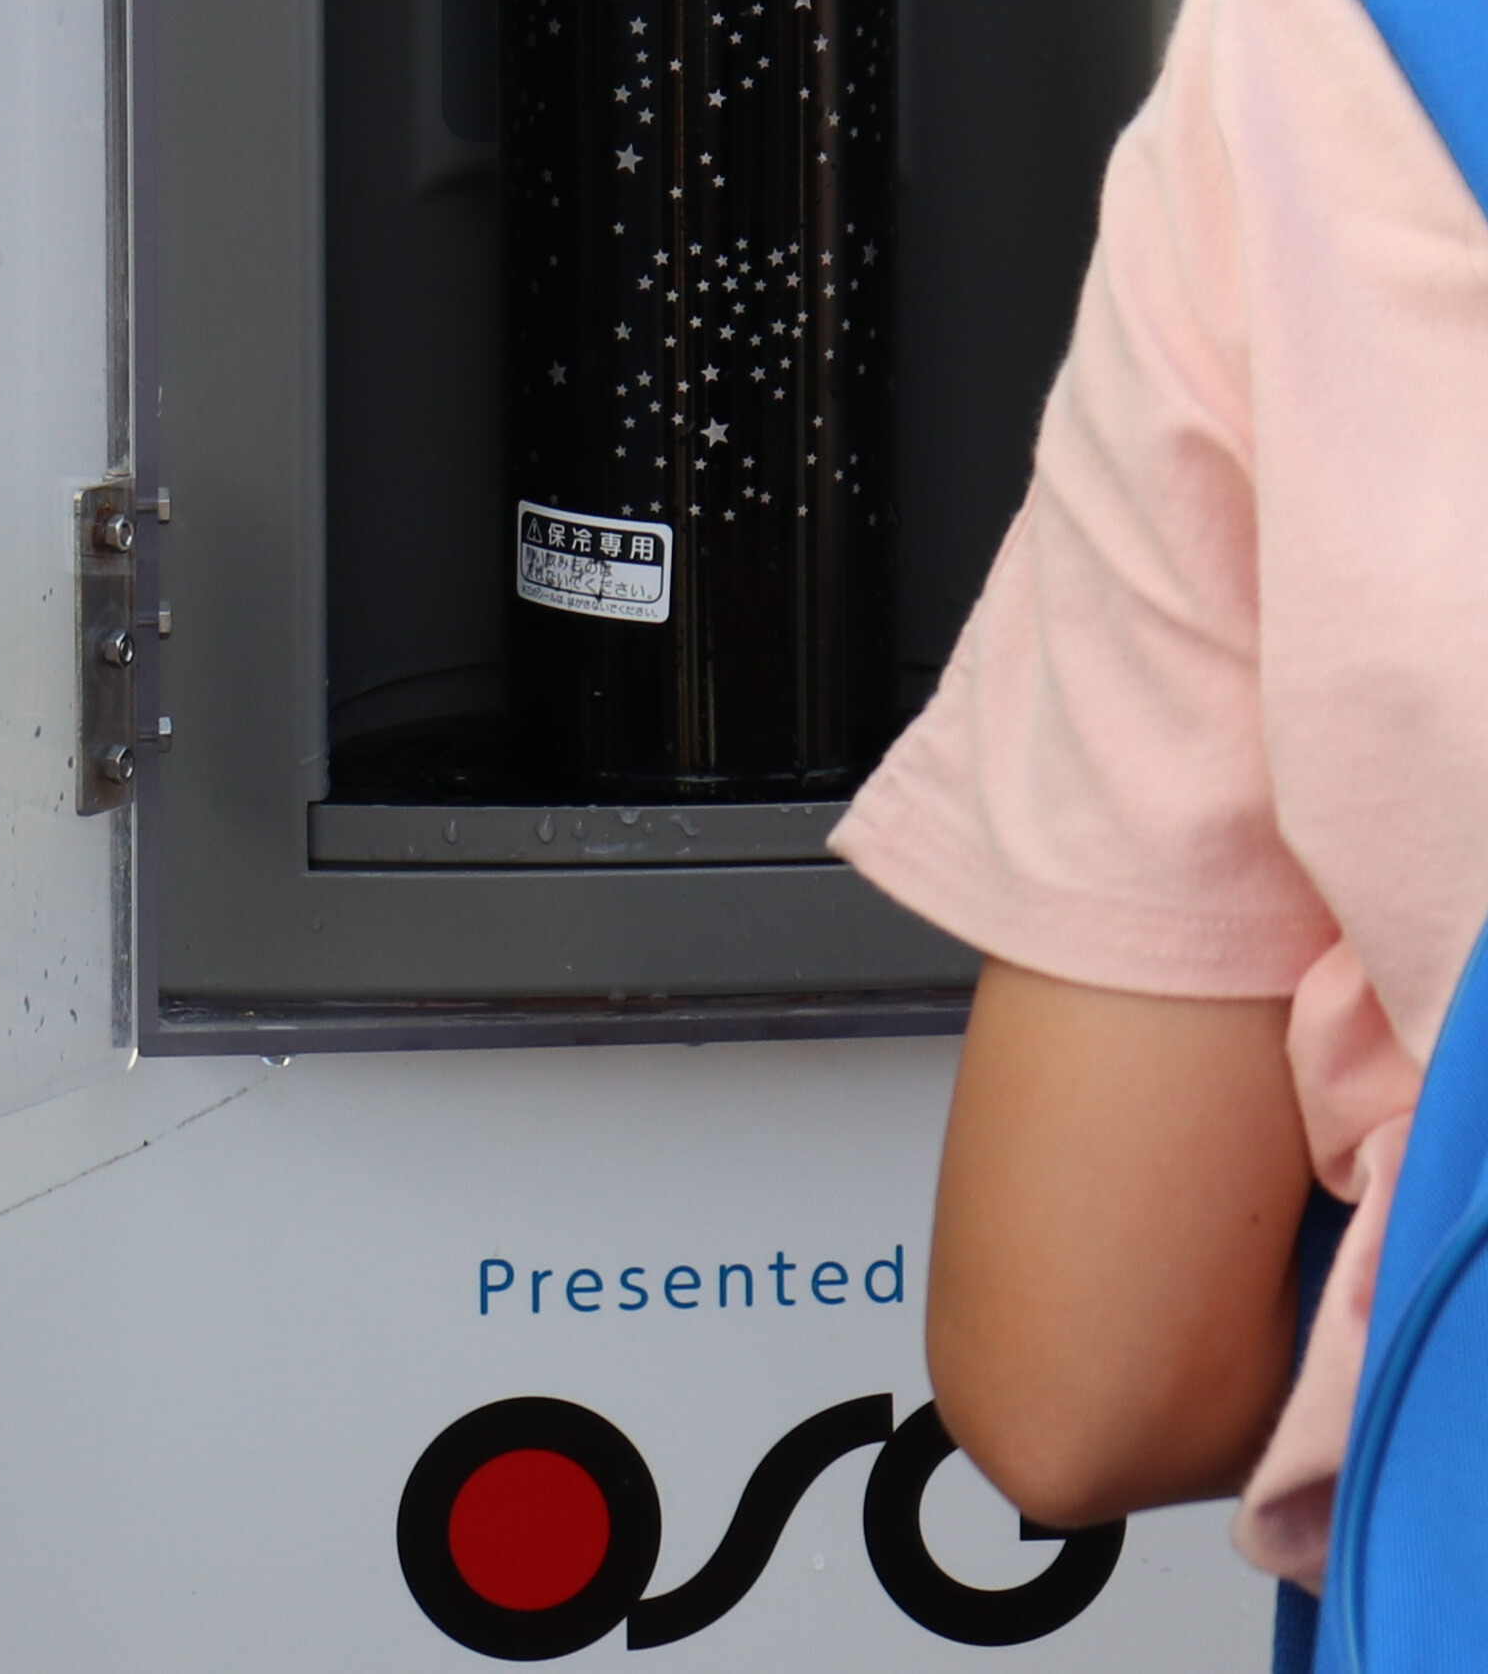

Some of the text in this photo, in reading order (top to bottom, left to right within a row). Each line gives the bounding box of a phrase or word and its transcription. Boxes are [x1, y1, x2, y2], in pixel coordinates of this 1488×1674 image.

[548, 522, 655, 561] 保冷専用
[479, 1244, 905, 1315] Presented
